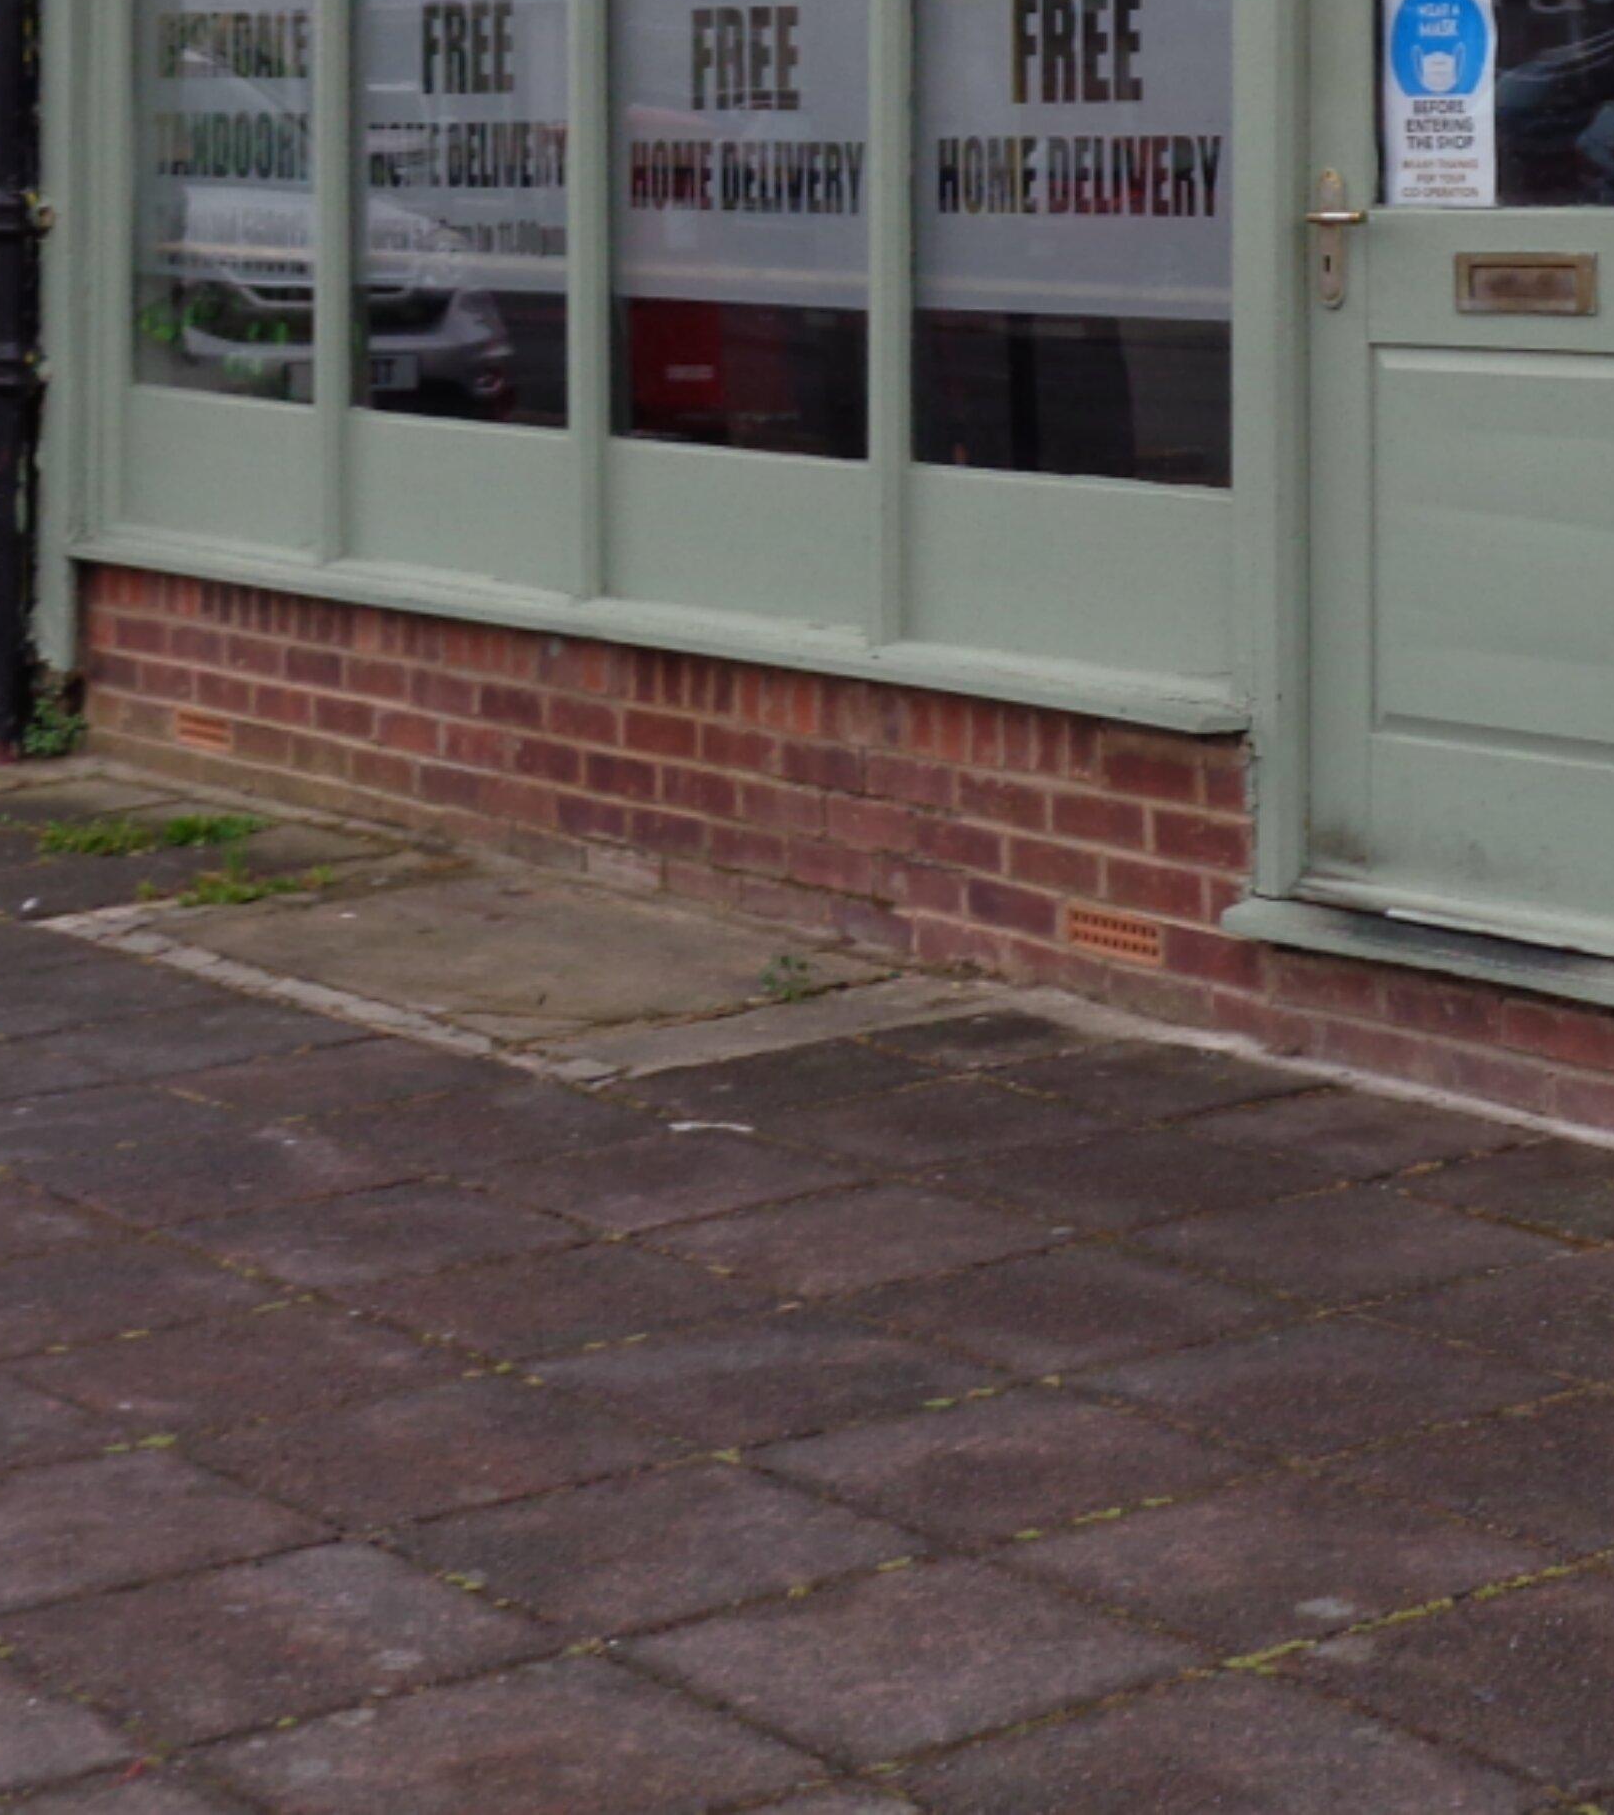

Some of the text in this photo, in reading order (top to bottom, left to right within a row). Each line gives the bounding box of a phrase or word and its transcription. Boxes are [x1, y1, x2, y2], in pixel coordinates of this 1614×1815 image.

[690, 6, 799, 111] FREE
[1405, 116, 1475, 134] ENTERING
[1413, 99, 1466, 115] BEFORE
[447, 120, 569, 188] DELIVERY
[937, 135, 1222, 216] HOME DELIVERY
[1406, 135, 1475, 151] THE SHOP
[629, 140, 865, 215] HOME DELIVERY
